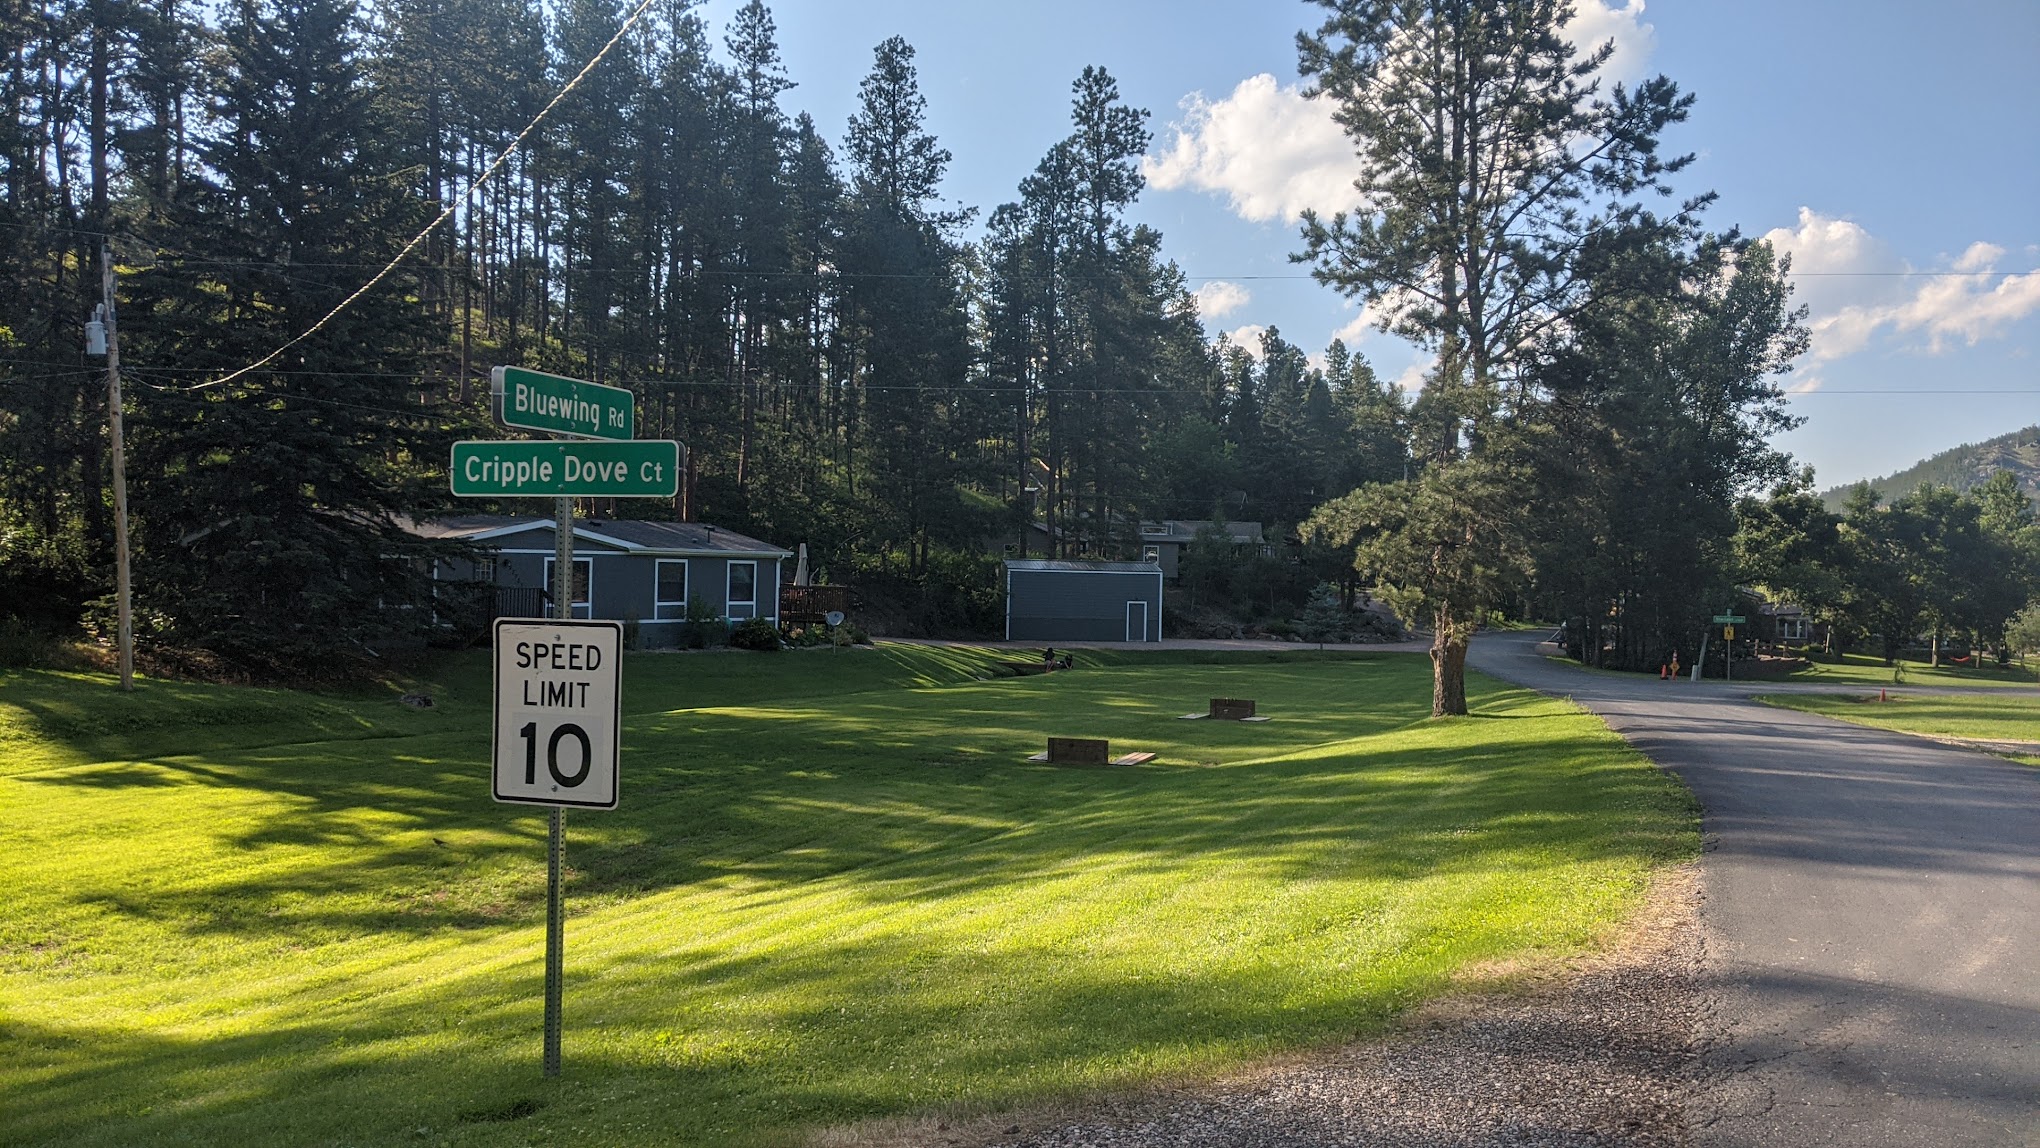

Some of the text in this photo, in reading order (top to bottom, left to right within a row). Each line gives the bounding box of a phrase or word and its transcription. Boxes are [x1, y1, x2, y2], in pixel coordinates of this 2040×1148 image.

[515, 383, 624, 432] Bluewing Rd
[465, 455, 663, 488] Cripple Dove Ct
[516, 641, 601, 671] SPEED
[523, 679, 590, 708] LIMIT
[520, 721, 592, 788] 10
